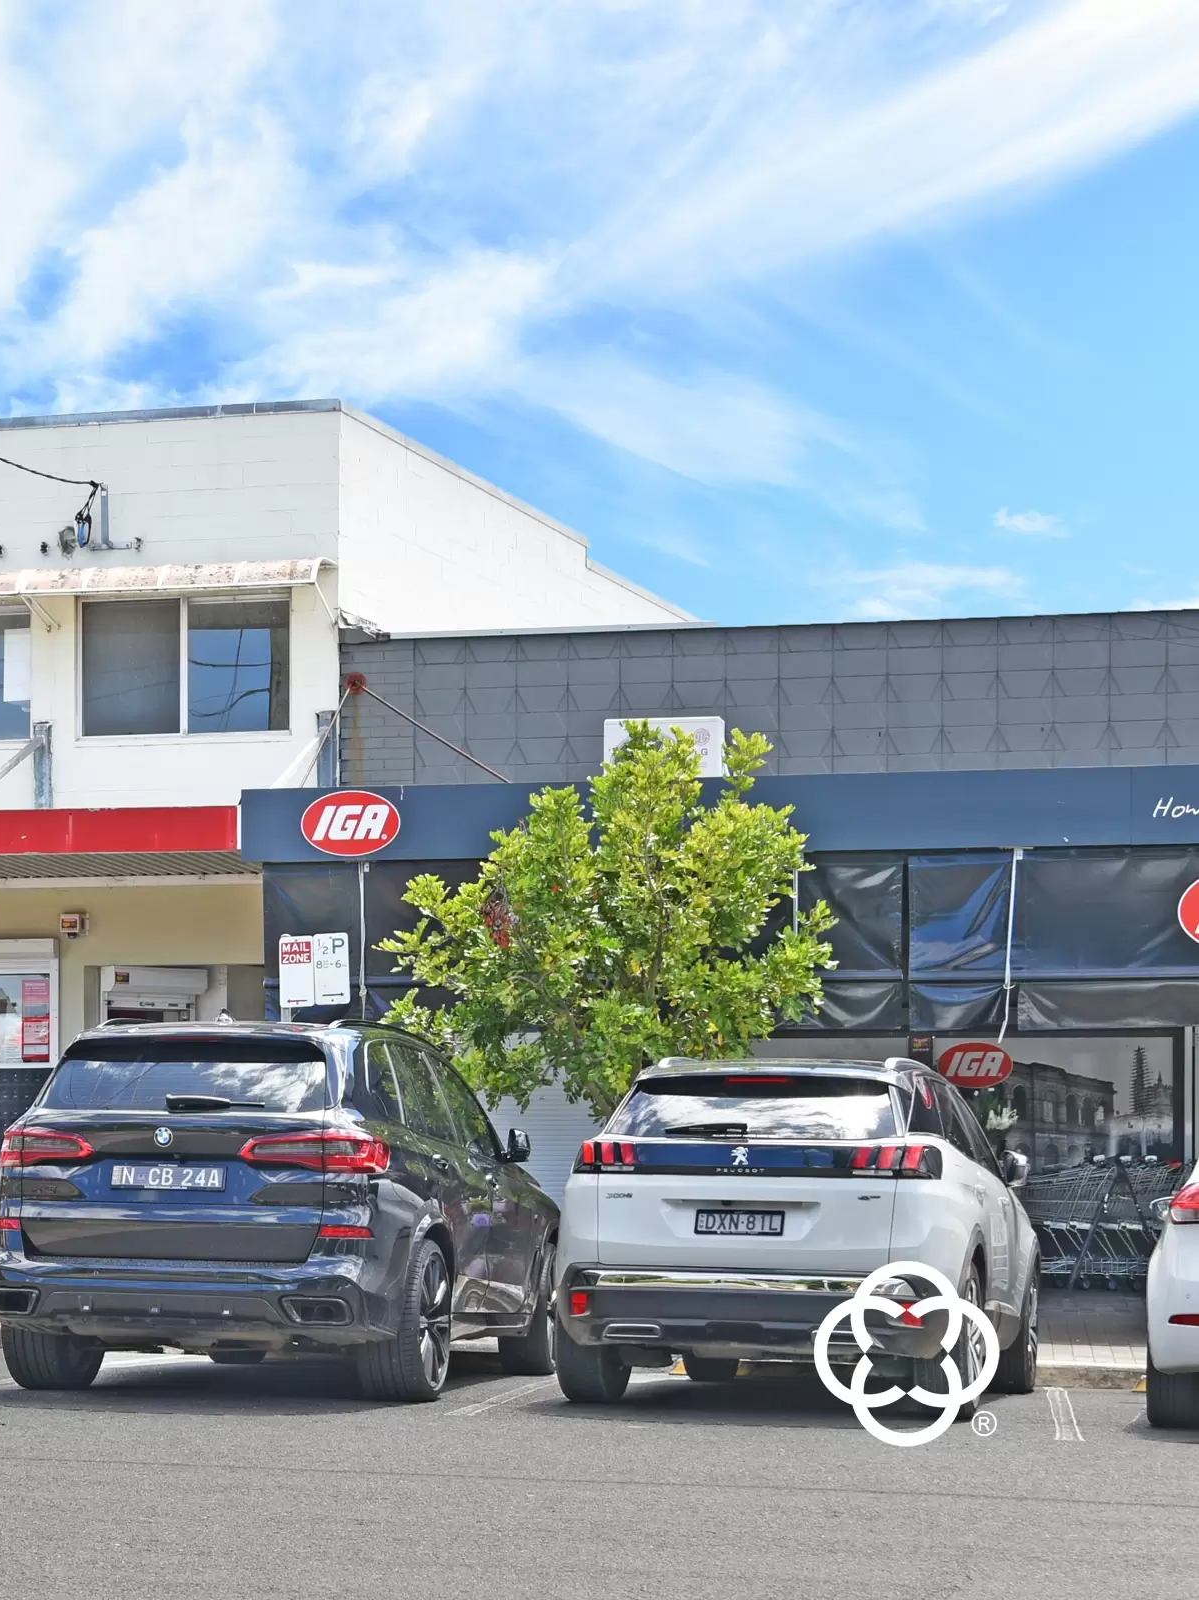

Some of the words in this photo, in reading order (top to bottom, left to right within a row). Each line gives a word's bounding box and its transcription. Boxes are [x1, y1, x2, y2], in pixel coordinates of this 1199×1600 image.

[311, 804, 390, 841] IGA
[282, 942, 310, 953] MAIL
[282, 953, 310, 964] ZONE
[945, 1051, 1005, 1077] IGA
